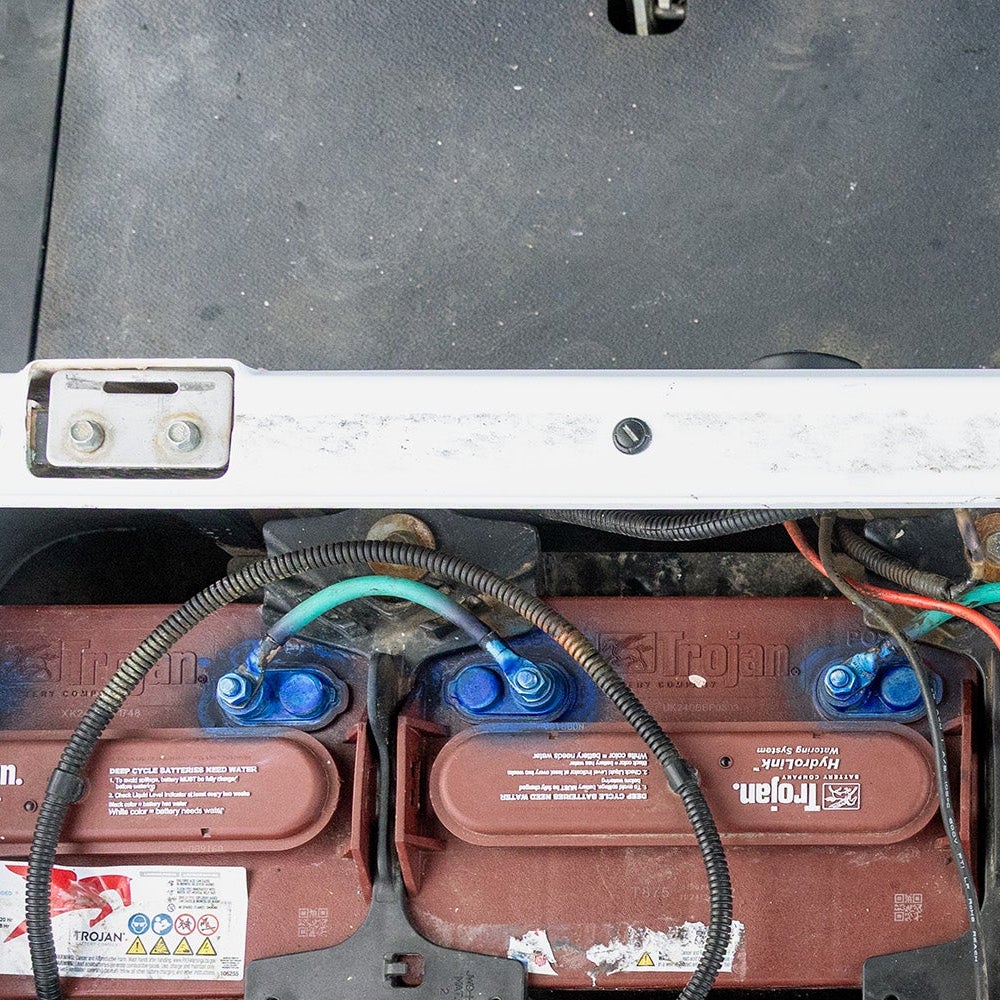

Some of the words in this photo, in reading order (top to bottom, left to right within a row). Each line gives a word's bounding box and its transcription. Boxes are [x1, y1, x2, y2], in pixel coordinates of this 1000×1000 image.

[757, 746, 793, 755] System
[796, 746, 839, 755] Watering
[160, 766, 204, 774] BATTERIES
[75, 931, 124, 942] TROJAN
